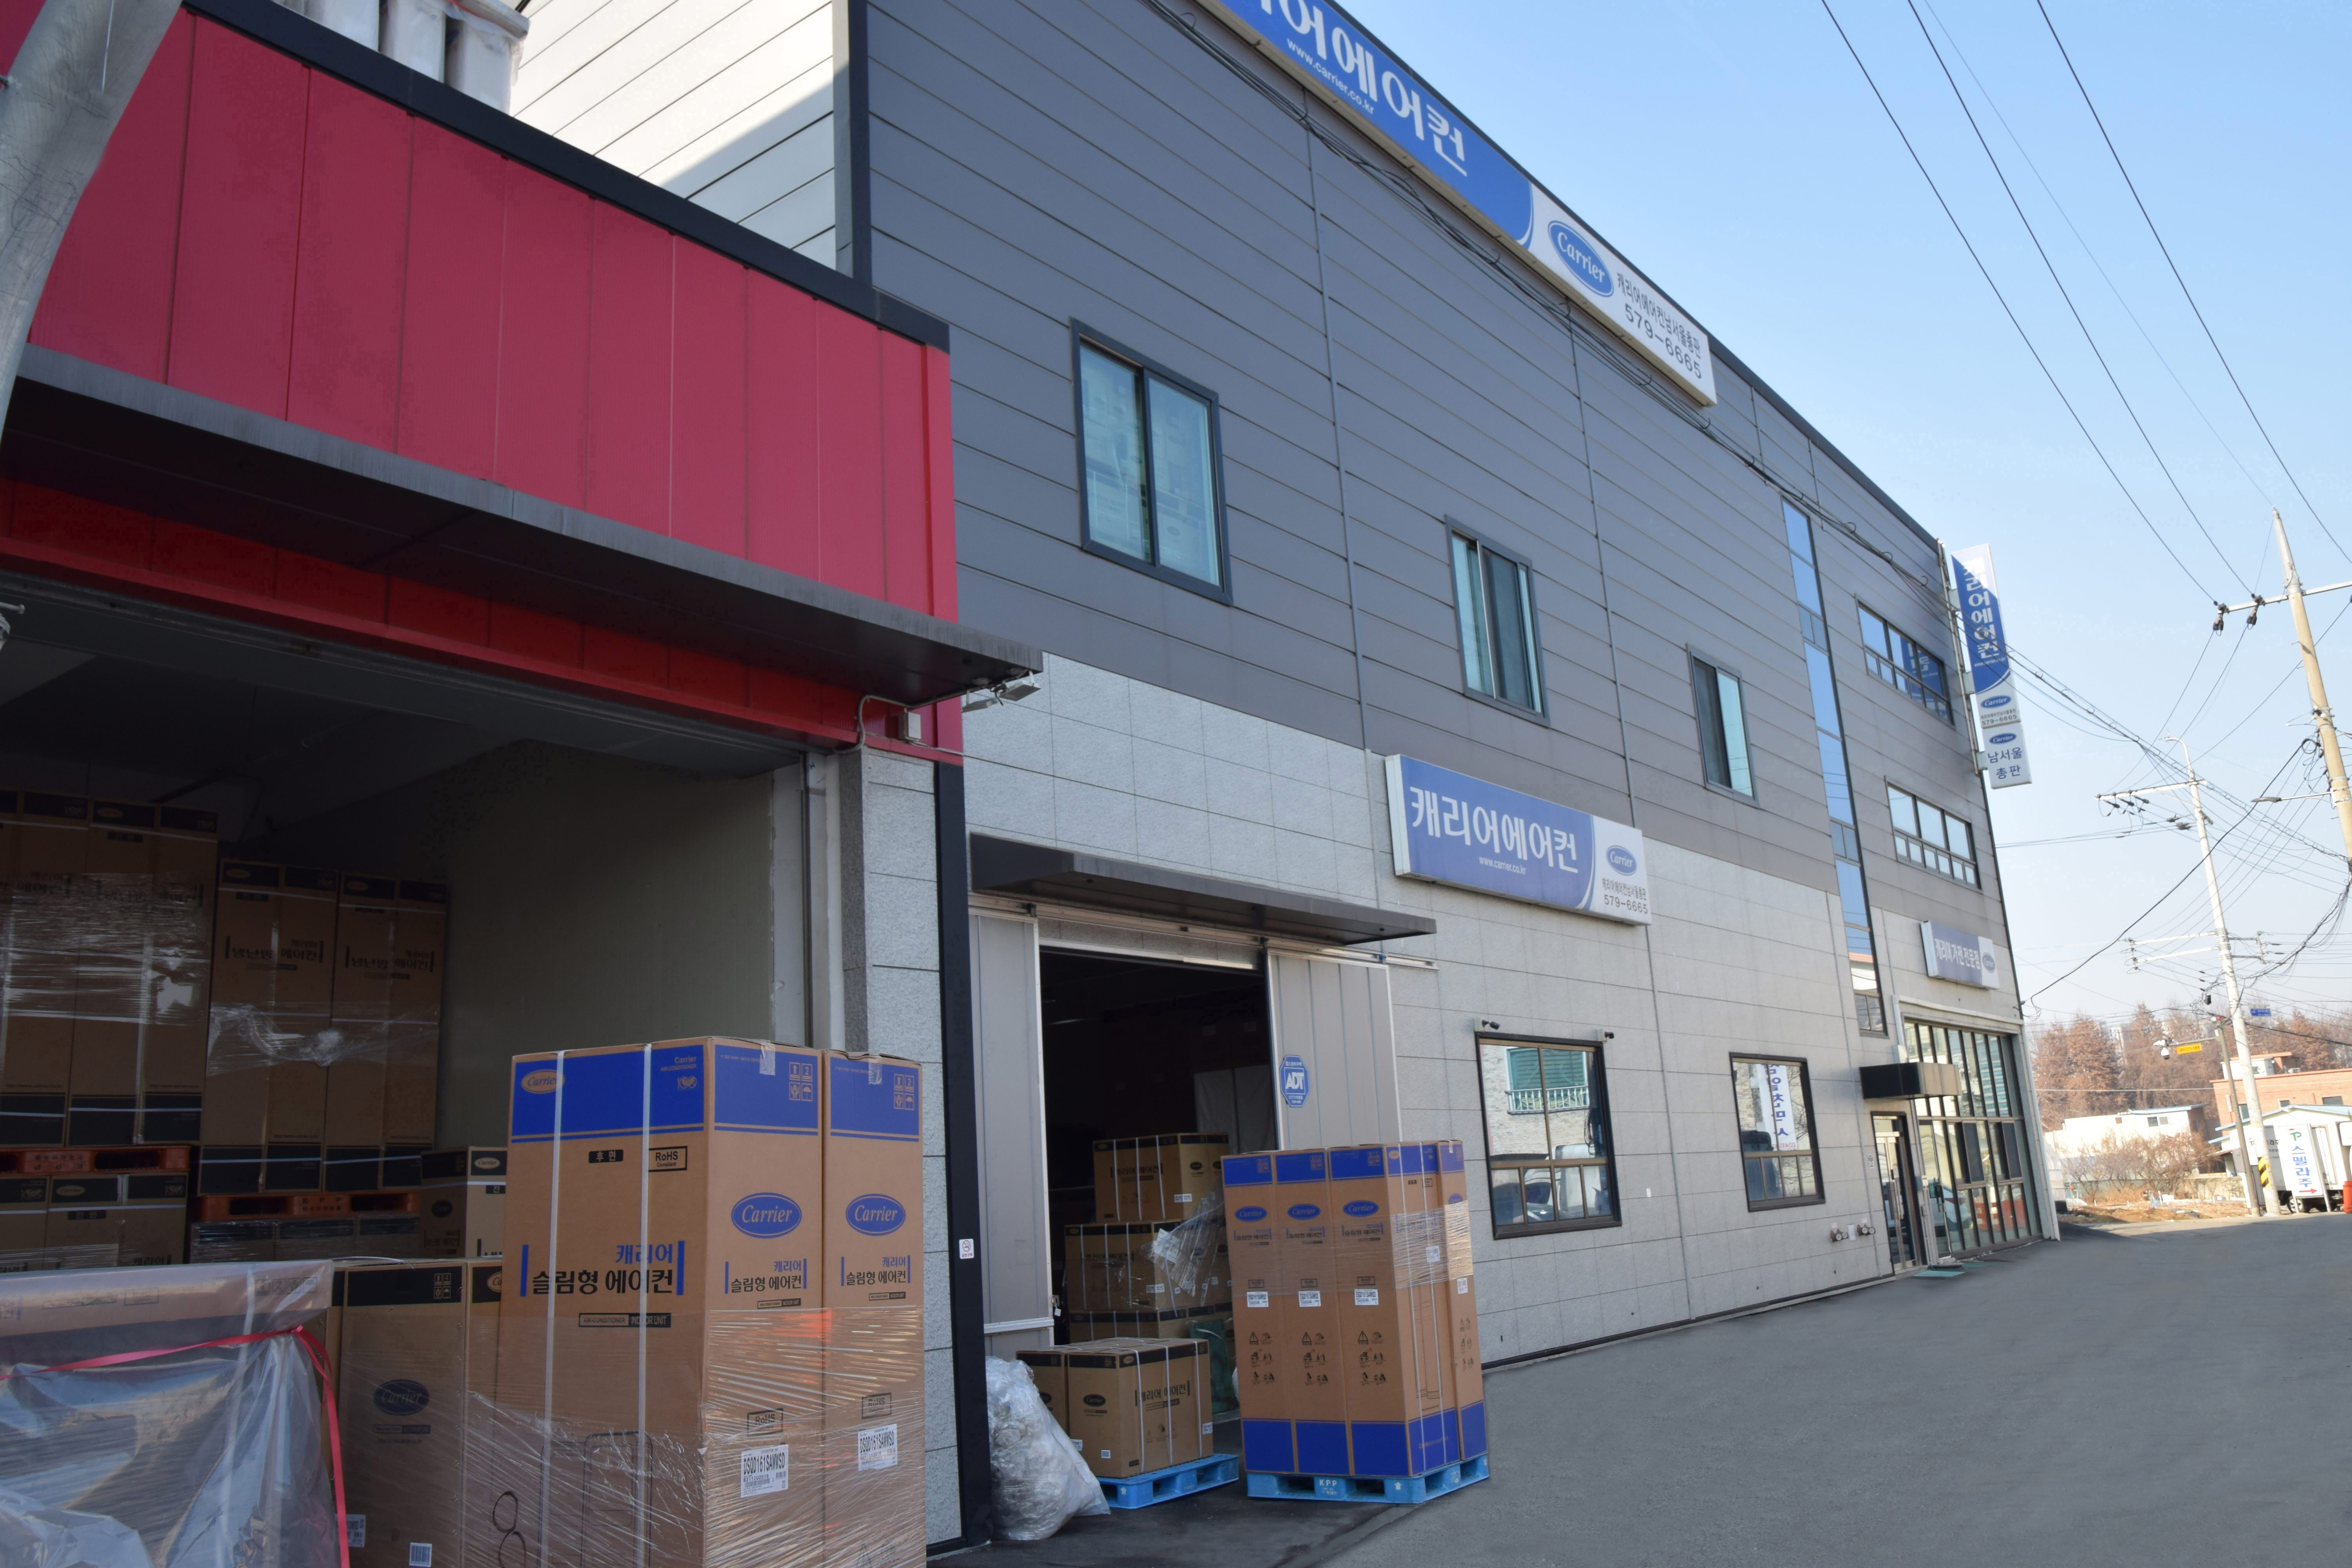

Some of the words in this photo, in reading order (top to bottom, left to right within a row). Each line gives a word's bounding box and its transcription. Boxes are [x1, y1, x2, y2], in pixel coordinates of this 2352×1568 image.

[1287, 38, 1374, 114] www.carrier.co.kr
[1261, 0, 1467, 176] 어에어컨
[1557, 231, 1605, 283] Carrier
[1625, 303, 1701, 379] 579-6665
[1984, 697, 2007, 706] Carrier
[1982, 714, 2017, 726] 579-6665
[1993, 735, 2013, 743] Carrier
[1988, 747, 2023, 764] 남서울
[1996, 764, 2021, 780] 총판
[1409, 786, 1578, 874] 캐리어에어컨
[1479, 856, 1526, 875] www.carrier.co.kr
[1610, 850, 1633, 868] Carrier
[1604, 894, 1648, 915] 579-6665
[674, 1056, 697, 1064] Carrier
[527, 1076, 557, 1087] Carrier
[1286, 1072, 1304, 1089] ADT
[655, 1151, 678, 1161] RoHS
[1117, 1167, 1136, 1175] 리어
[742, 1205, 792, 1223] Carrier
[855, 1205, 897, 1222] Carrier
[1348, 1205, 1373, 1213] Carrier
[615, 1243, 673, 1265] 캐리어
[882, 1256, 906, 1268] 캐리어
[773, 1260, 801, 1272] 캐리어
[532, 1269, 599, 1295] 슬림형
[605, 1269, 673, 1294] 에어컨
[731, 1277, 766, 1293] 슬림형
[769, 1275, 802, 1290] 에어컨
[846, 1271, 875, 1285] 슬림형
[878, 1270, 906, 1284] 에어컨
[631, 1316, 653, 1325] INDOR
[654, 1316, 667, 1325] UNIT
[381, 1389, 421, 1404] Carrier
[860, 1430, 894, 1454] DSQD161SAWWSD
[743, 1452, 785, 1475] DSQD161SAWWSD
